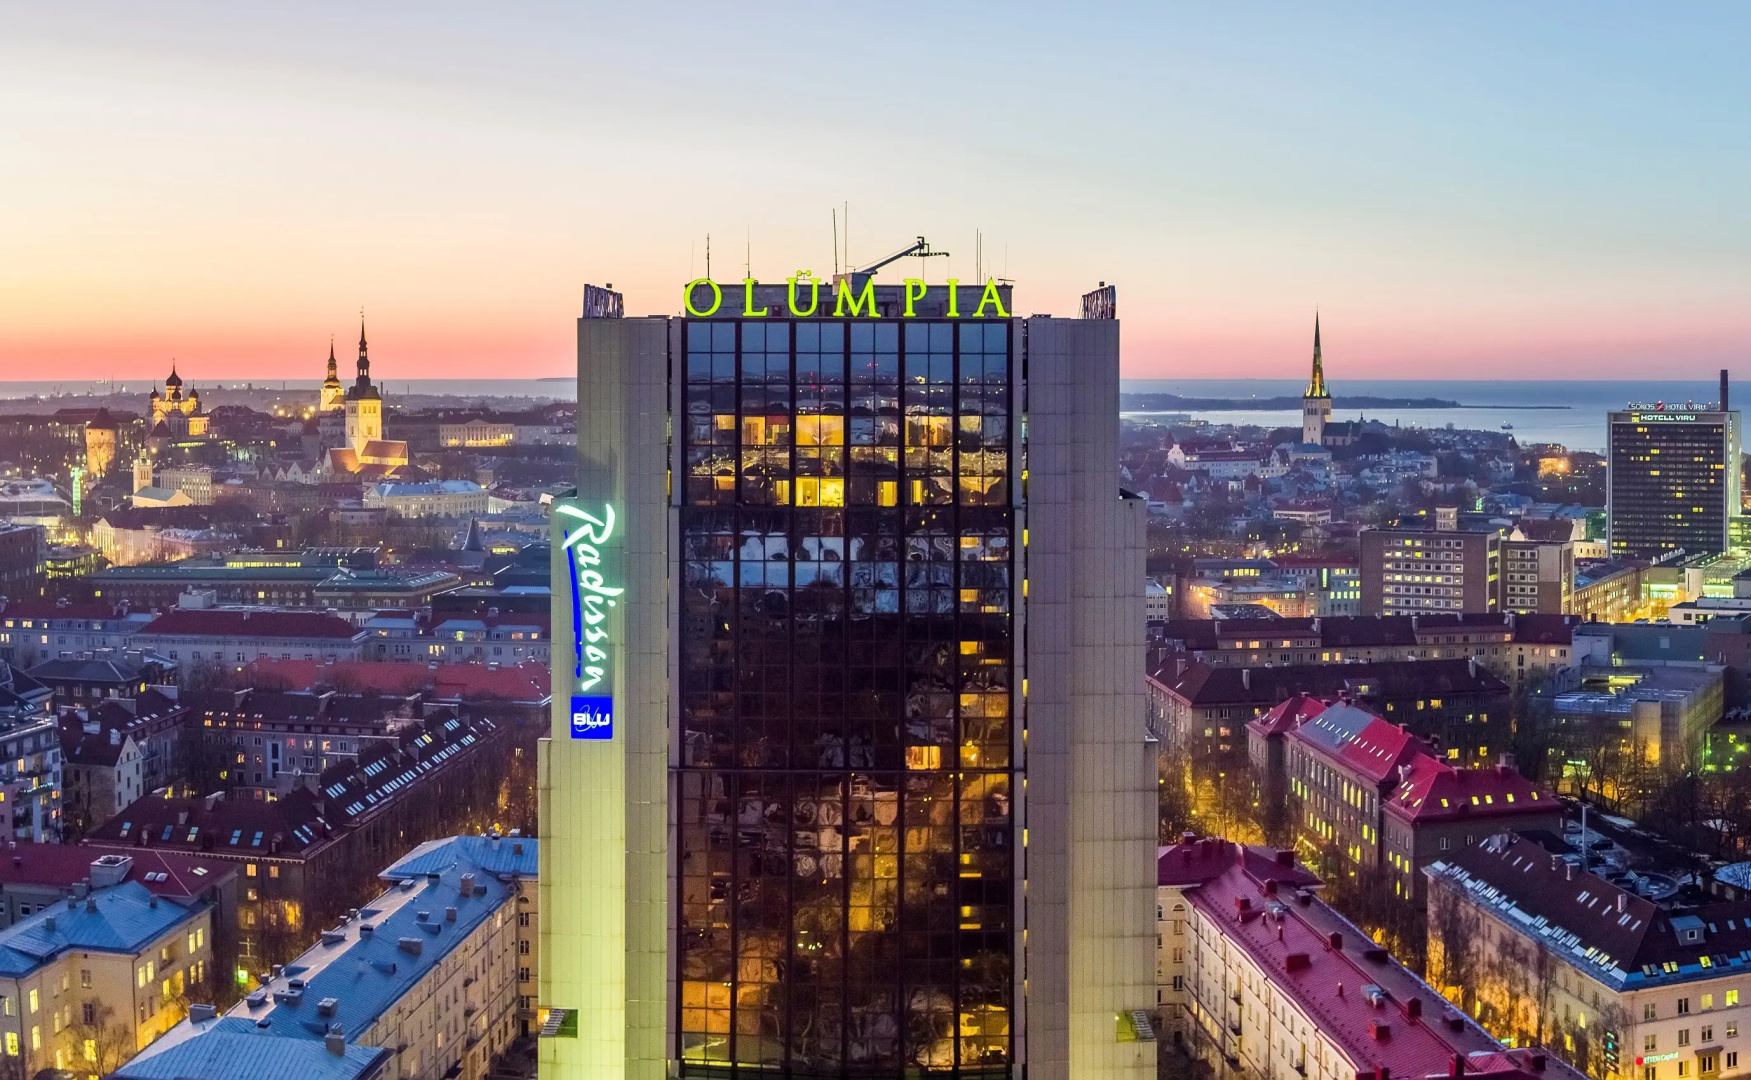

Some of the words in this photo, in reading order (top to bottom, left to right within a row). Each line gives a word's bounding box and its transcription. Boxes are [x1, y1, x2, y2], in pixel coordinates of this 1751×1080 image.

[684, 270, 1010, 317] OLÜMPIA
[1631, 403, 1655, 411] SOKOS
[1665, 403, 1687, 411] HOTEL
[1688, 403, 1706, 411] VIRU
[555, 503, 625, 691] Radisson
[573, 713, 610, 726] BLU
